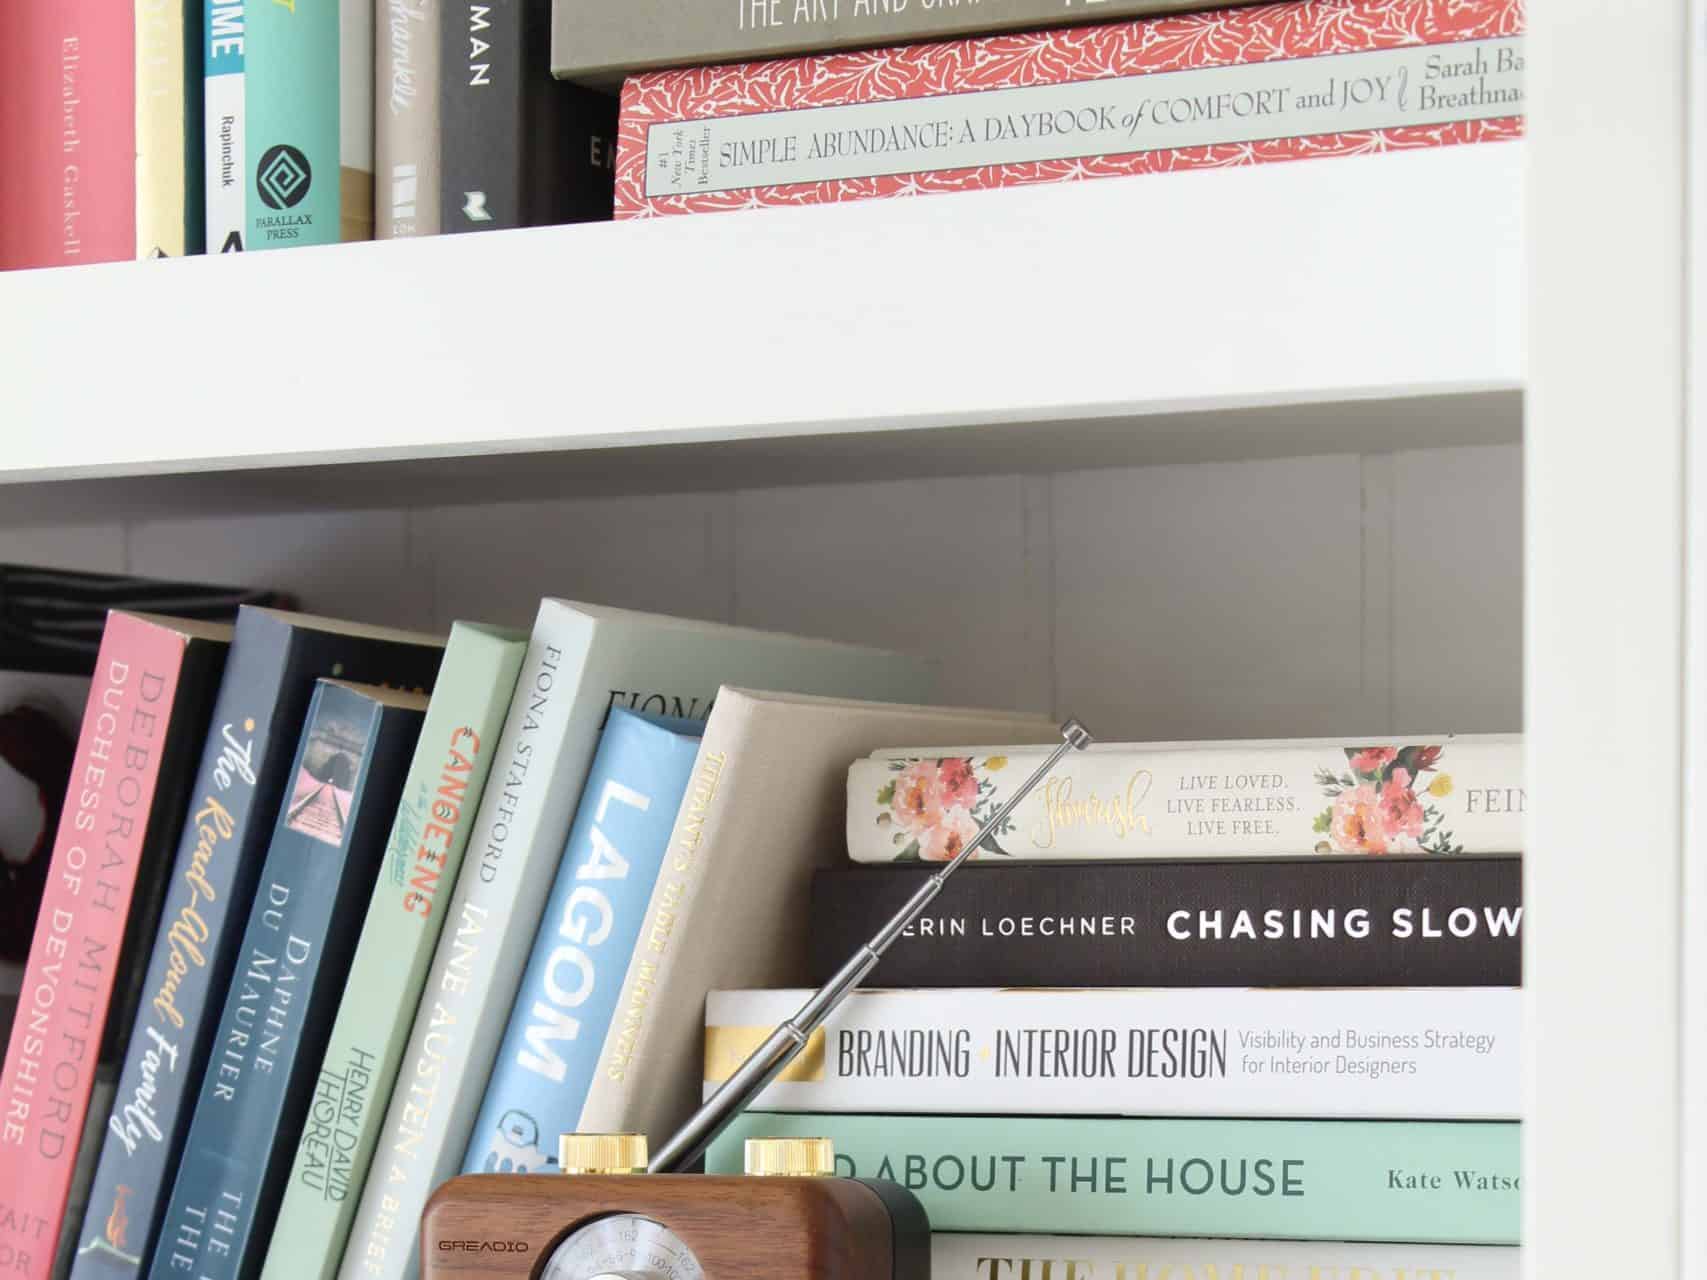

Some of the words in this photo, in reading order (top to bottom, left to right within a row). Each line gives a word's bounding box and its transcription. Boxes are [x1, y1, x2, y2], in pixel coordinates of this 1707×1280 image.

[211, 0, 244, 58] ME
[469, 5, 491, 86] MAN
[1424, 47, 1488, 79] Sarah
[63, 37, 80, 152] Elizabeth
[719, 135, 797, 168] SIMPLE
[807, 118, 954, 161] ABUNDANCE:
[958, 118, 976, 144] A
[984, 105, 1116, 141] DAYBOOK
[1122, 98, 1151, 137] of
[1151, 87, 1291, 125] COMFORT
[1295, 78, 1336, 111] and
[1338, 75, 1392, 113] JOY
[219, 115, 235, 187] Rapinchuk
[658, 152, 669, 168] #1
[671, 159, 682, 185] New
[673, 129, 684, 155] York
[698, 127, 711, 185] Bestseller
[63, 165, 80, 256] Gaskell
[256, 214, 313, 228] PARALLAX
[266, 228, 299, 240] PRESS
[523, 645, 562, 733] FIONA
[75, 660, 129, 832] DUCHESS
[214, 722, 256, 791] The
[93, 672, 165, 913] DEBORAH
[479, 745, 532, 884] STAFFORD
[1166, 798, 1204, 815] LIVE
[1211, 796, 1301, 814] FEARLESS.
[1179, 775, 1217, 791] LIVE
[1223, 774, 1289, 791] LOVED.
[402, 725, 481, 920] CANOEING
[1186, 820, 1225, 837] LIVE
[1231, 819, 1280, 835] FREE.
[63, 846, 87, 896] OF
[153, 795, 235, 1029] Read-Aloud
[261, 883, 290, 933] DU
[516, 779, 651, 1084] LAGOM
[982, 916, 1136, 937] LOECHNER
[1166, 907, 1371, 941] CHASING
[1391, 906, 1523, 940] SLOW
[442, 901, 488, 992] JANE
[4, 909, 73, 1146] DEVONSHIRE
[213, 948, 277, 1102] MAURIER
[253, 933, 313, 1075] DAPHNE
[607, 959, 656, 1083] MANNERS
[39, 936, 108, 1161] MITFORD
[837, 1029, 971, 1079] BRANDING
[994, 1028, 1117, 1079] INTERIOR
[1127, 1028, 1228, 1079] DESIGN
[1238, 1028, 1307, 1055] Visibility
[1310, 1029, 1341, 1050] and
[1346, 1029, 1419, 1050] Business
[1424, 1029, 1496, 1055] Strategy
[1241, 1055, 1267, 1075] for
[1270, 1055, 1330, 1075] Interior
[1335, 1056, 1417, 1079] Designers
[110, 1025, 178, 1157] Family
[338, 1047, 376, 1126] HENRY
[393, 1003, 457, 1160] AUSTEN
[301, 1071, 340, 1192] THOREAU
[328, 1129, 358, 1203] DAVID
[389, 1166, 407, 1184] A
[875, 1154, 1025, 1192] ABOUT
[1042, 1156, 1128, 1194] THE
[1146, 1157, 1306, 1197] HOUSE
[1387, 1168, 1441, 1191] Kate
[169, 1206, 209, 1272] THE
[207, 1190, 243, 1258] THE
[367, 1195, 401, 1275] BRIEF
[438, 1239, 529, 1253] GREADIO
